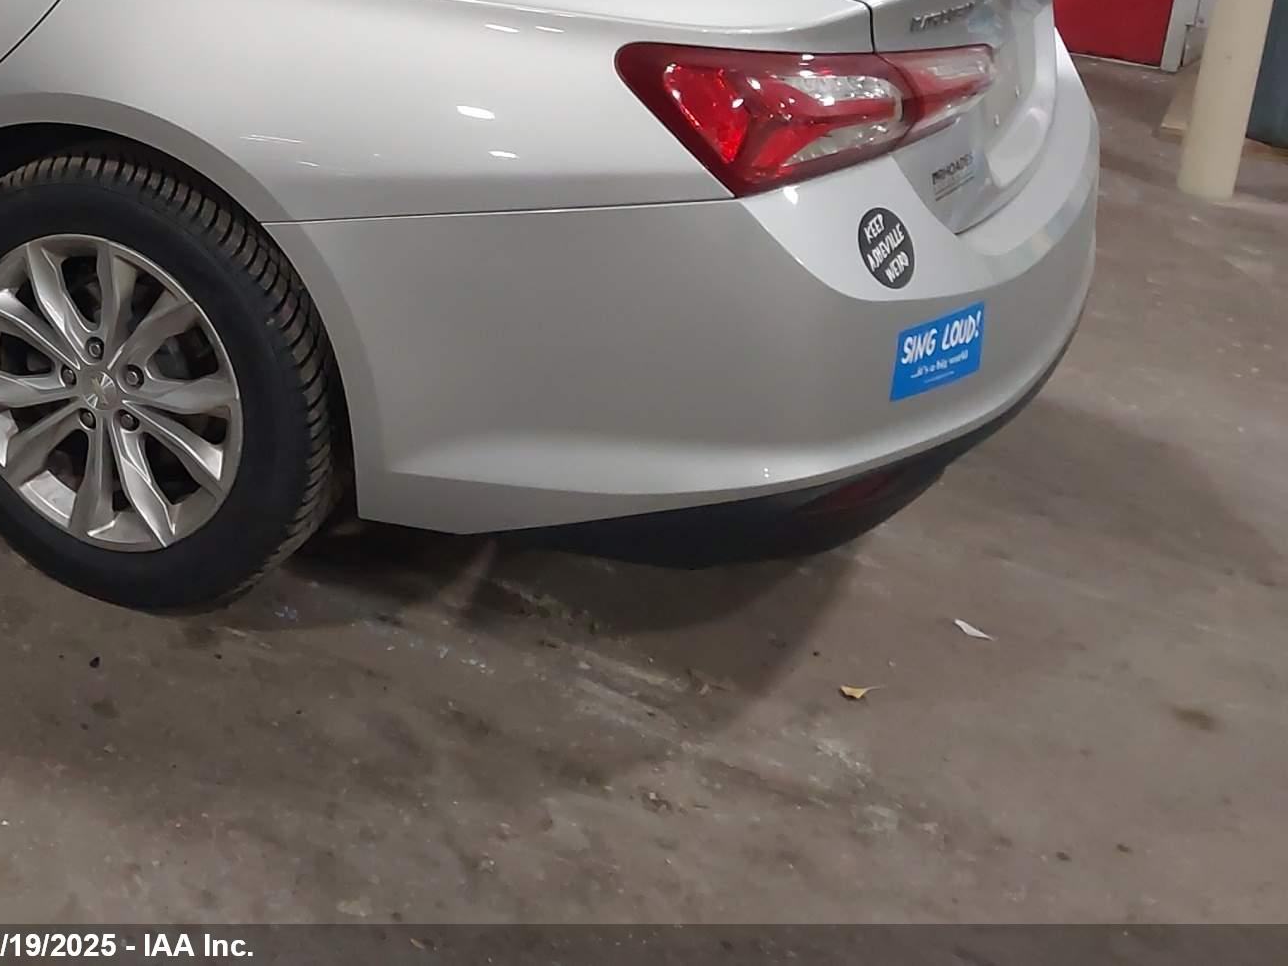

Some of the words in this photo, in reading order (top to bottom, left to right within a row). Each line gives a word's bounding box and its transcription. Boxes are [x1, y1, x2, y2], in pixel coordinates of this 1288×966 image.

[863, 214, 885, 244] KEEP
[867, 223, 905, 272] ASHEVILLE
[885, 251, 910, 283] WEIRD
[901, 328, 937, 364] SING
[941, 310, 982, 351] LOUD!
